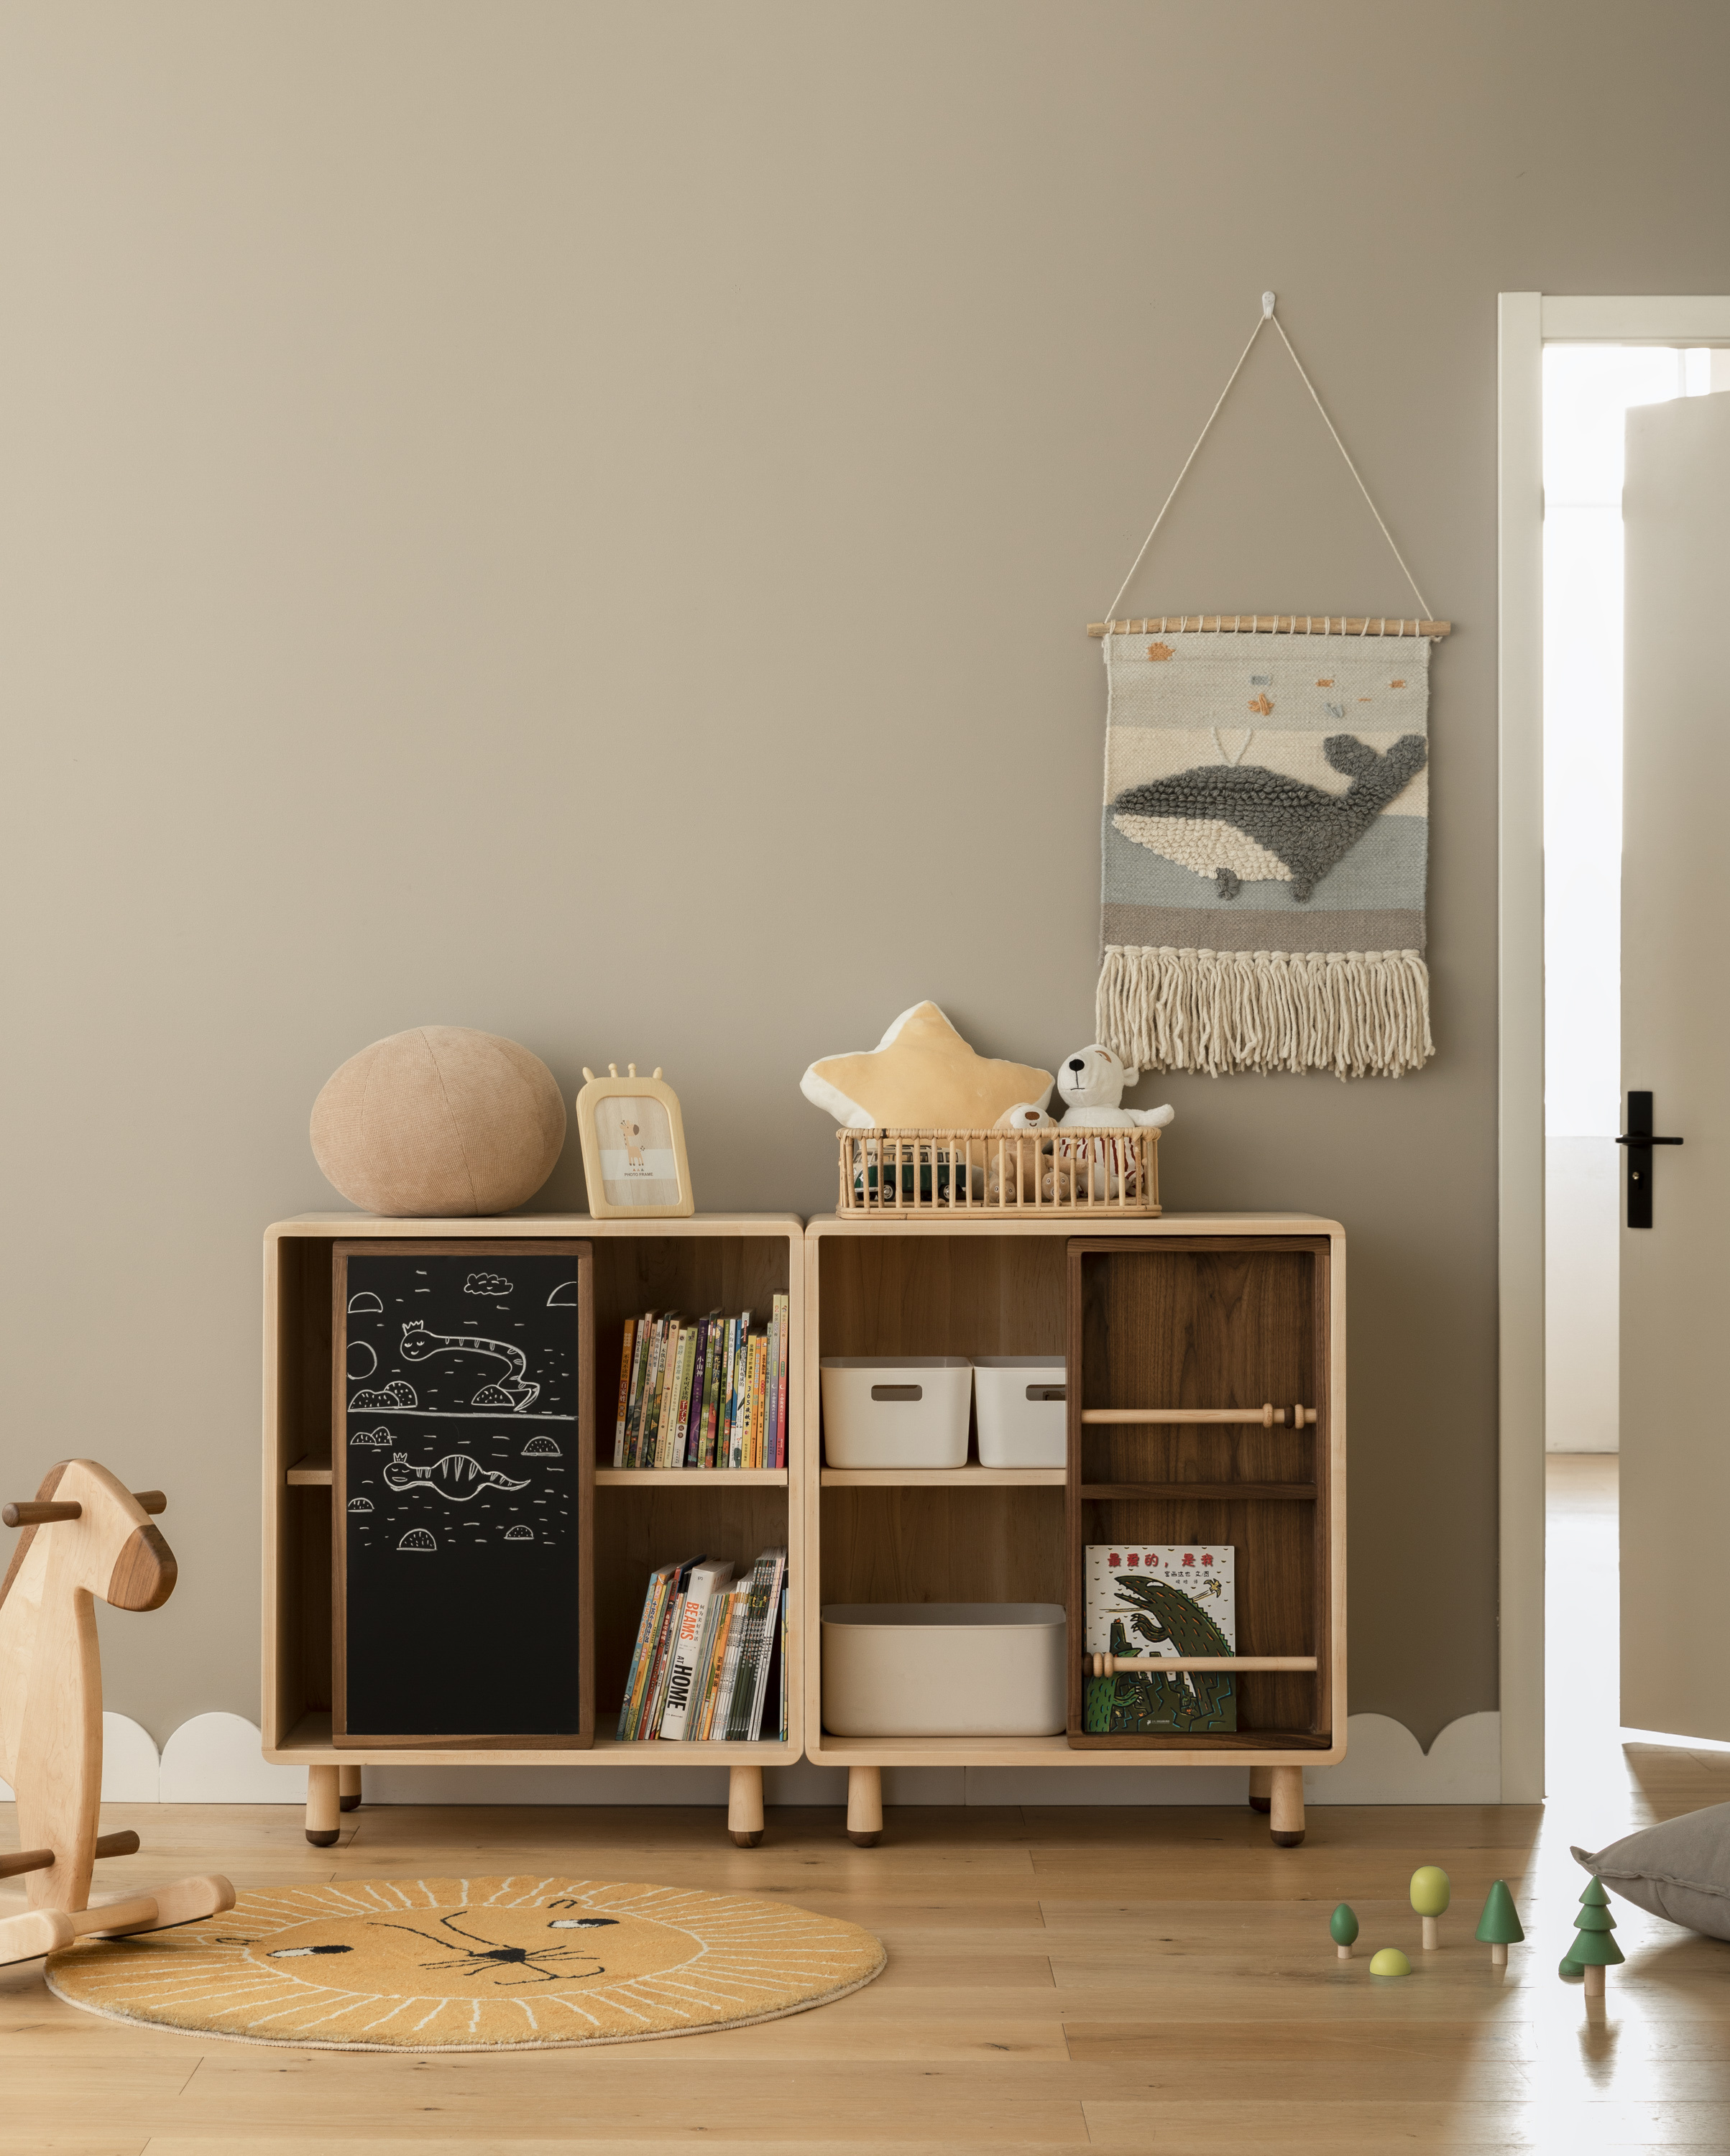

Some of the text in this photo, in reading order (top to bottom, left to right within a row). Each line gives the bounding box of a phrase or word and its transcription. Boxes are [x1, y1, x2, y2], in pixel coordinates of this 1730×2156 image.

[679, 1401, 688, 1424] 千字文
[1108, 1552, 1215, 1568] 最爱的，是我
[638, 1600, 651, 1644] 十万个为什么
[644, 1600, 658, 1644] 十万个为什么
[680, 1601, 699, 1641] BEAMS
[693, 1603, 705, 1641] 何为美好生活
[676, 1655, 685, 1664] AT
[667, 1664, 693, 1711] HOME
